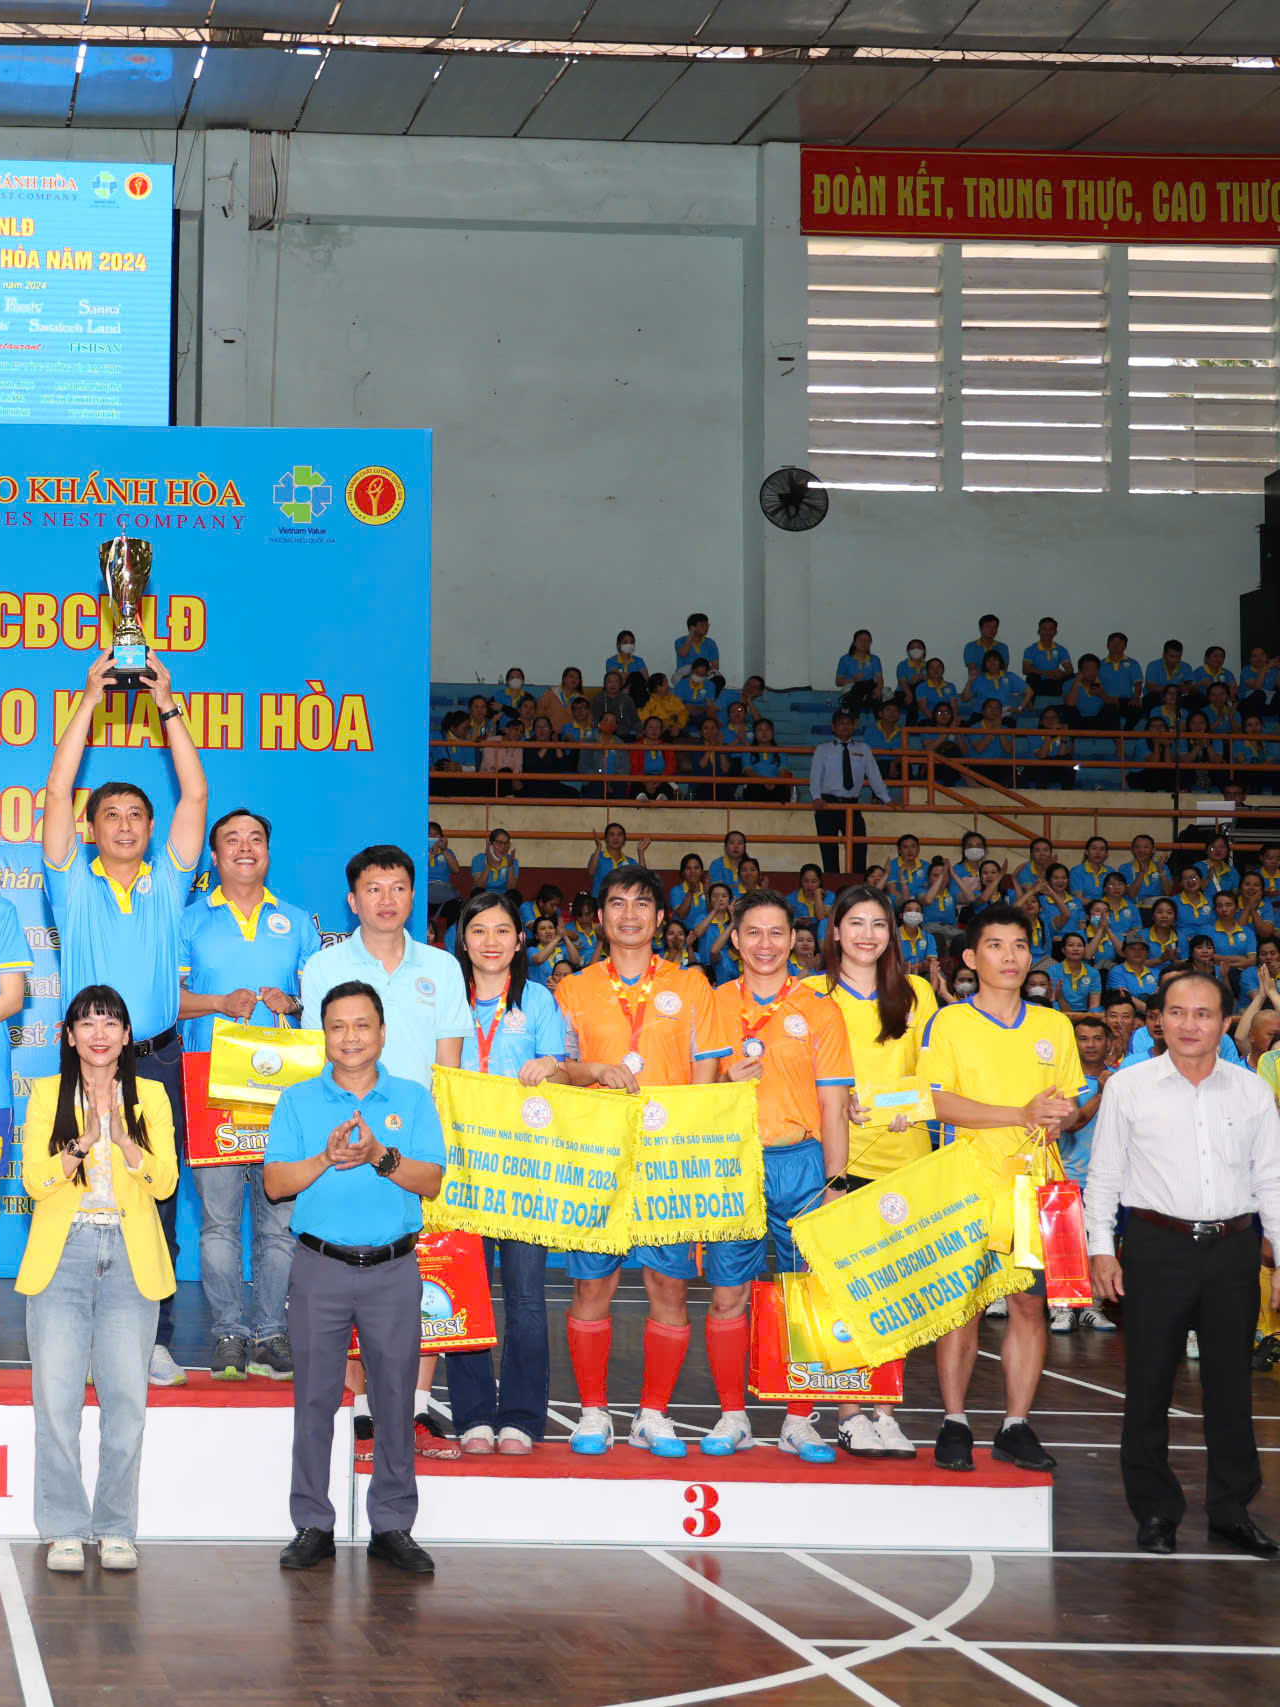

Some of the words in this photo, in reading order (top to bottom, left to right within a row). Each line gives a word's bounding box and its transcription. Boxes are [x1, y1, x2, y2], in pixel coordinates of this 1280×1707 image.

[812, 166, 886, 216] ĐOÀN
[897, 161, 954, 221] KẾT,
[963, 177, 1053, 220] TRUNG
[1062, 178, 1142, 230] THỰC,
[1152, 181, 1207, 223] CAO
[0, 245, 40, 269] HÒA
[46, 247, 93, 271] NĂM
[99, 252, 147, 272] 2024
[25, 281, 46, 289] 2024
[27, 470, 159, 506] KHÁNH
[164, 472, 246, 507] HÒA
[43, 512, 107, 528] NEST
[116, 513, 246, 530] COMPANY
[259, 679, 375, 752] HÒA
[215, 1123, 269, 1155] San
[468, 1149, 499, 1173] THAO
[502, 1155, 552, 1181] CBCNLĐ
[555, 1160, 584, 1187] NĂM
[587, 1169, 618, 1191] 2024
[645, 1160, 678, 1181] CNLĐ
[681, 1155, 711, 1178] NĂM
[715, 1157, 742, 1178] 2024
[445, 1175, 480, 1211] GIẢI
[483, 1187, 506, 1214] BA
[512, 1187, 560, 1223] TOÀN
[561, 1197, 612, 1229] ĐOÀN
[646, 1187, 692, 1221] TOÀN
[695, 1185, 745, 1218] ĐOÀN
[845, 1275, 874, 1302] HỘI
[869, 1264, 898, 1291] THAO
[933, 1230, 967, 1261] NĂM
[870, 1297, 908, 1337] GIẢI
[907, 1297, 927, 1322] BA
[919, 1271, 970, 1311] TOÀN
[421, 1314, 468, 1336] nest
[786, 1362, 873, 1391] Sanest
[683, 1483, 722, 1538] 3
